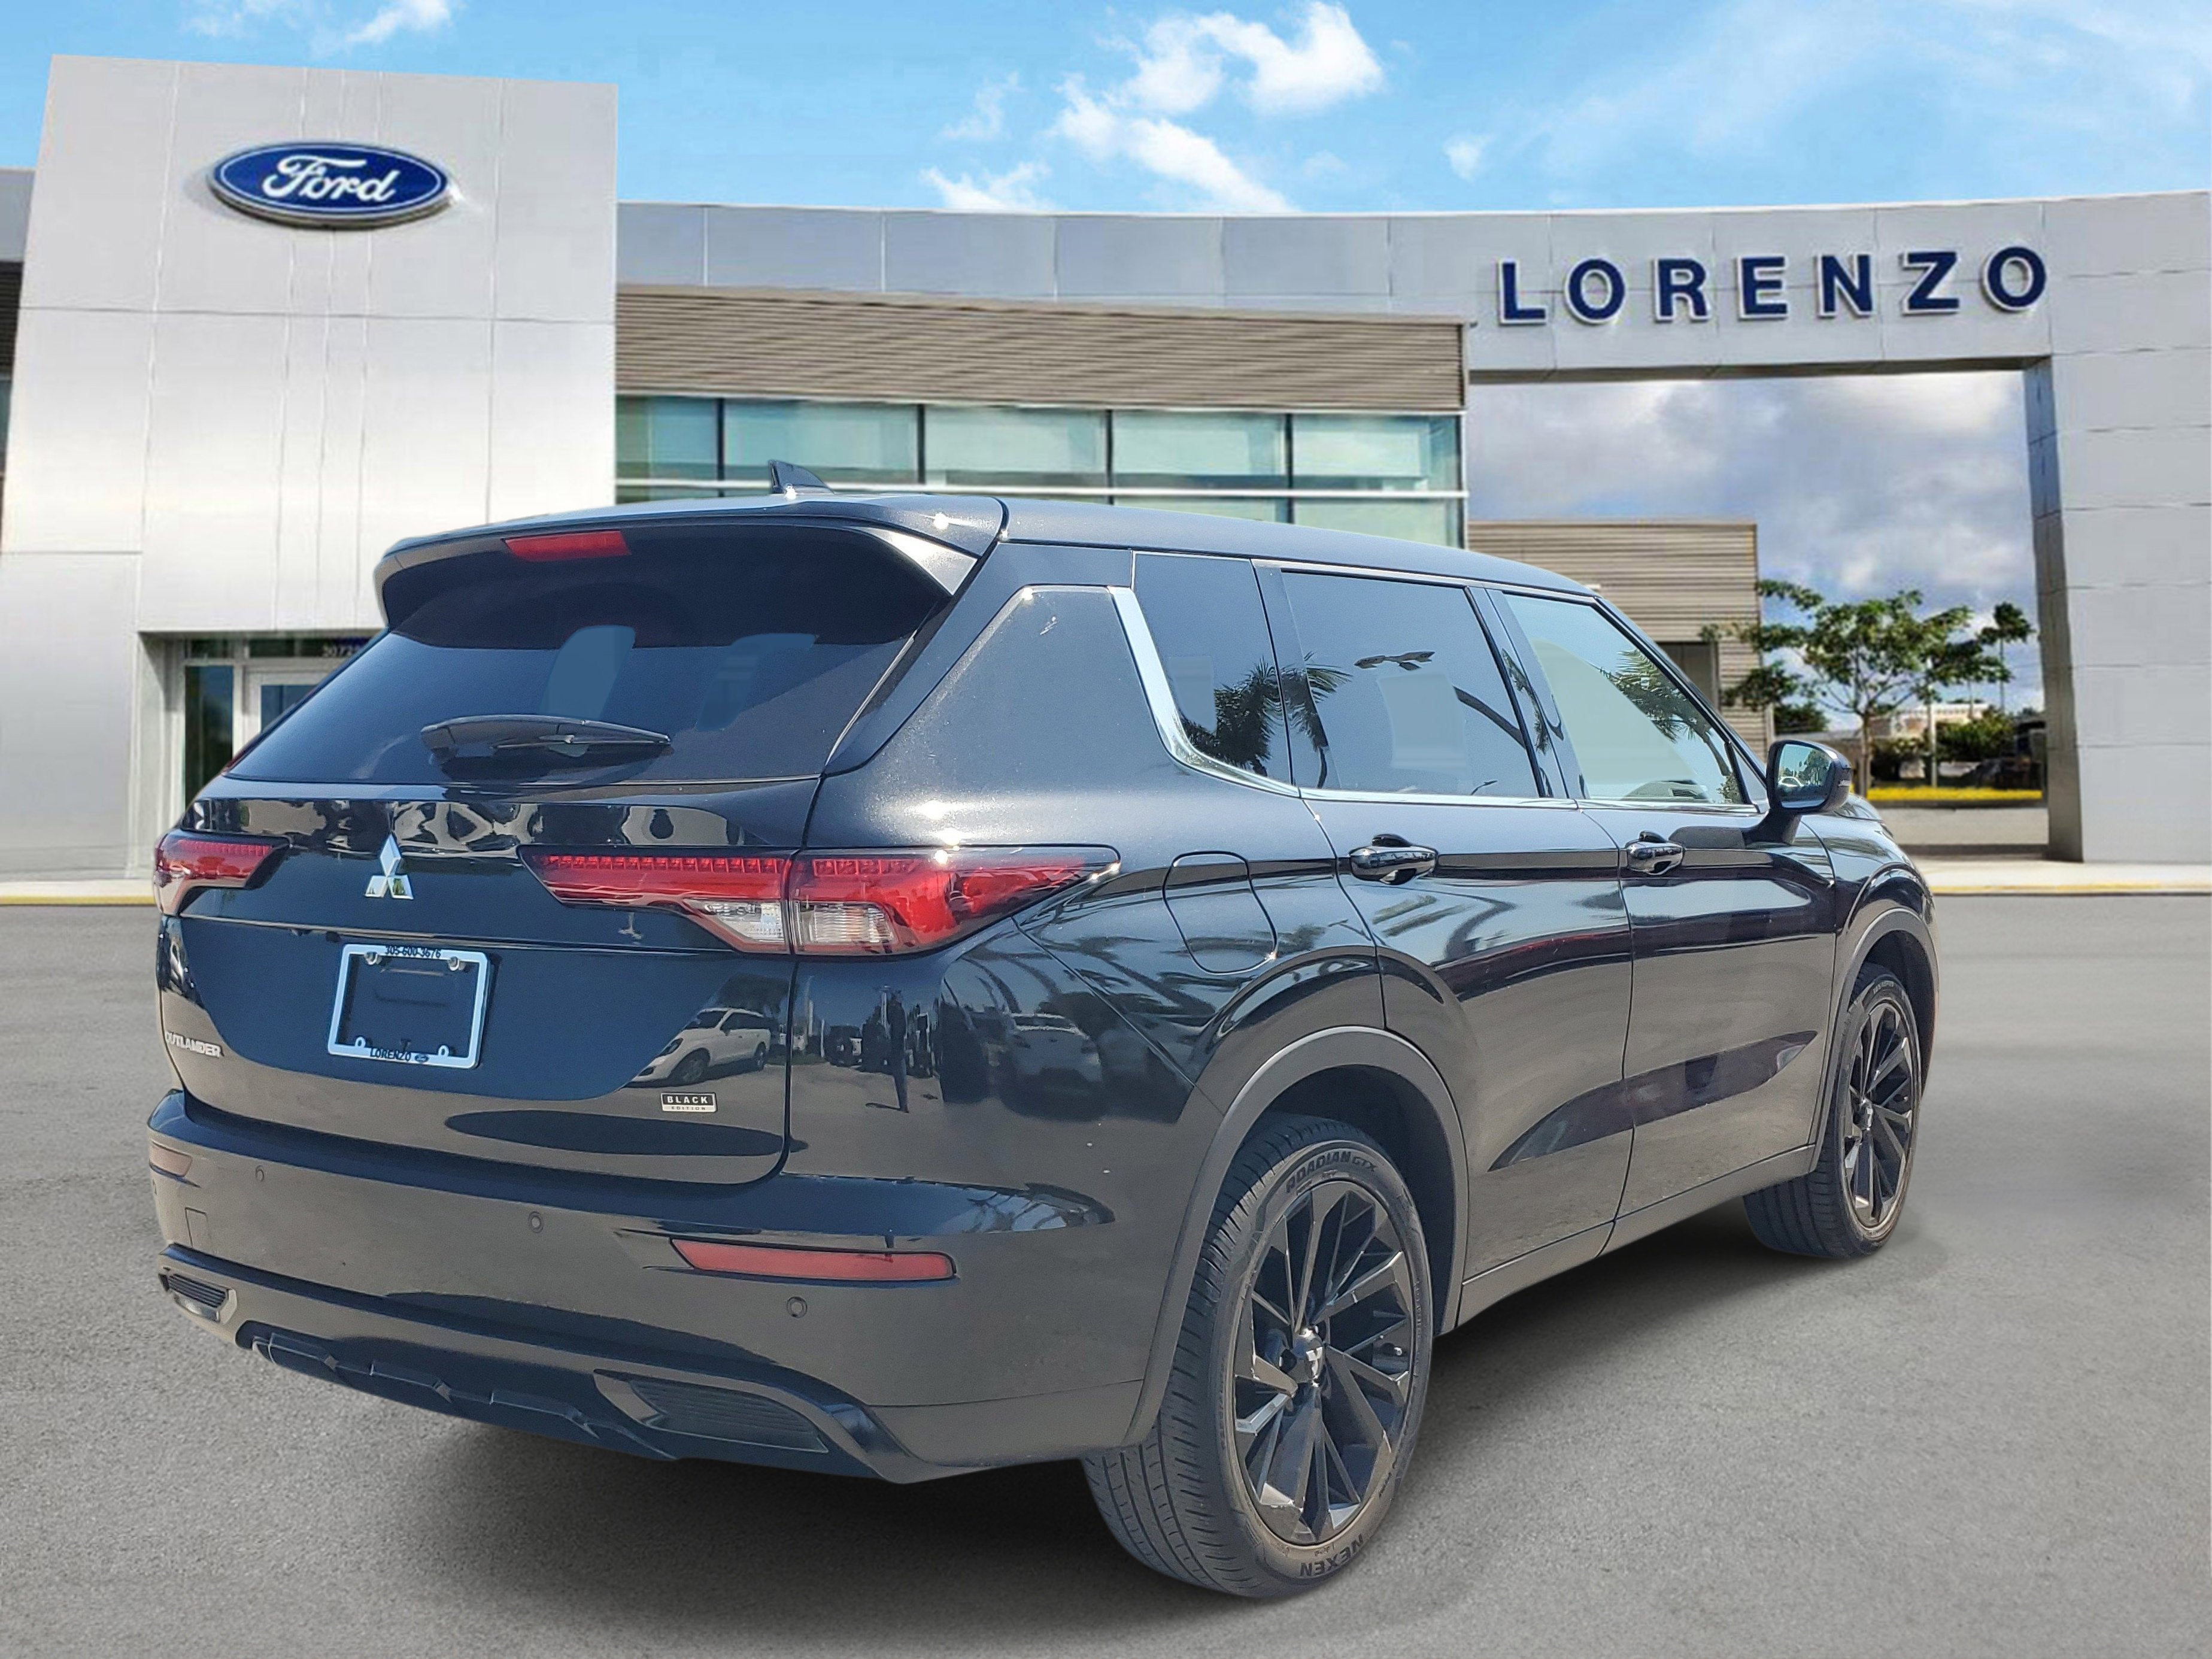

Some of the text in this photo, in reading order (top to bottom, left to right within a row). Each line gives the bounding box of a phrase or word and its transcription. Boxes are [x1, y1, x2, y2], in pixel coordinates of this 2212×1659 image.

[262, 154, 402, 202] Ford
[1501, 246, 2047, 321] LORENZO
[165, 1030, 221, 1058] OUTLANDER
[369, 1047, 411, 1061] LORENZO
[667, 1096, 708, 1104] BLACK
[1286, 1151, 1351, 1193] ROADIAN
[1299, 1533, 1364, 1576] NEXEN
